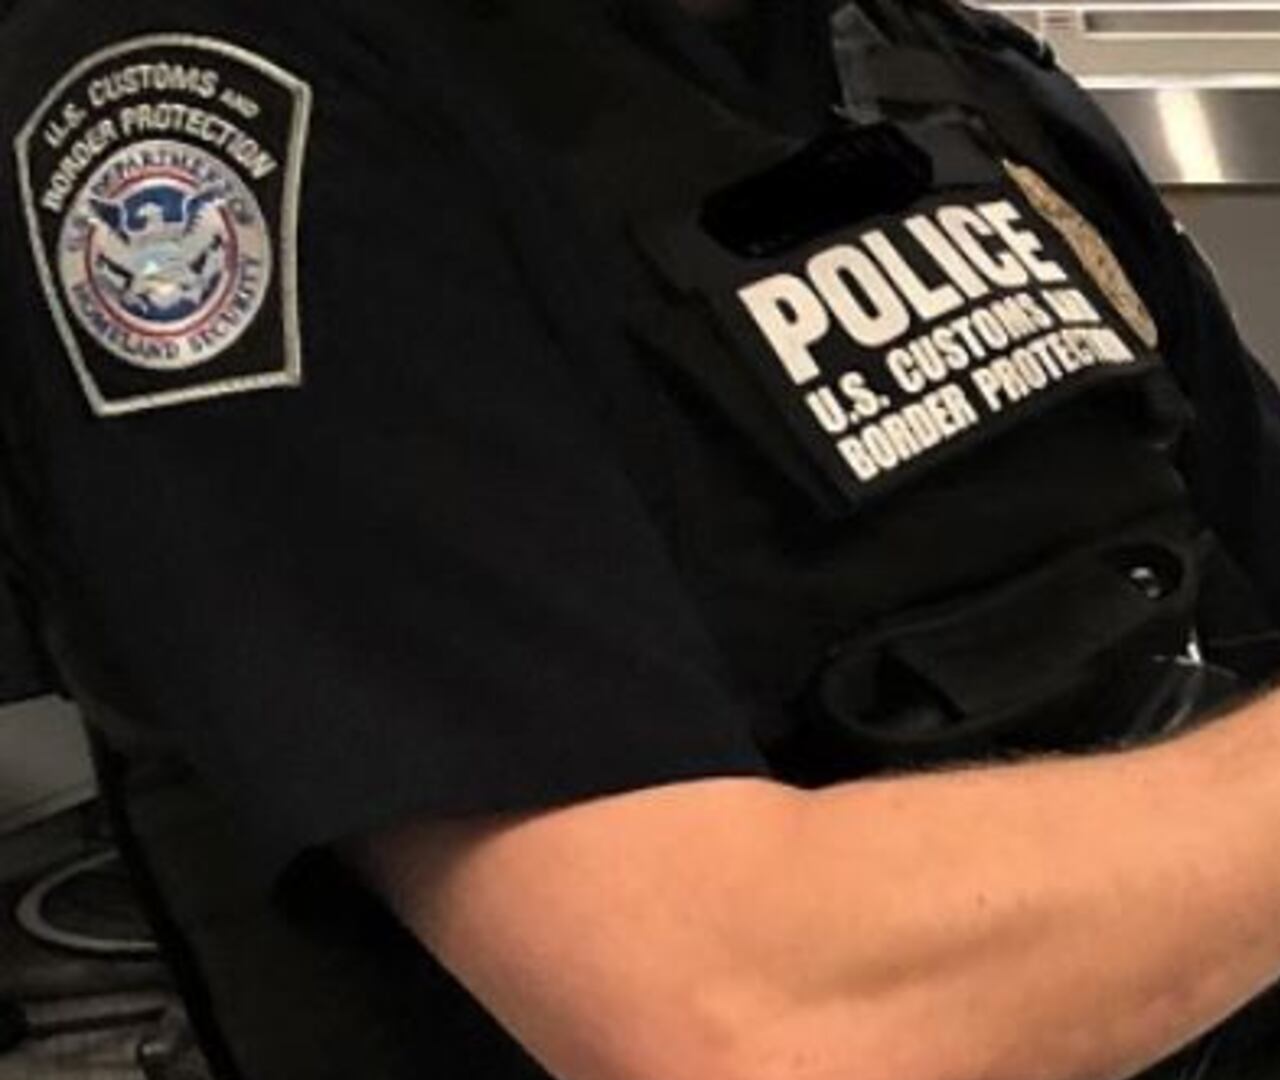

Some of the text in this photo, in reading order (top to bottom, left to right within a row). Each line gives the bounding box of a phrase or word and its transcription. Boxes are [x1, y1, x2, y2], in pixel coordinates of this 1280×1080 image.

[87, 62, 220, 107] CUSTOMS
[41, 102, 278, 214] BORDER PROTECTION
[737, 200, 1068, 386] POLICE
[804, 370, 891, 434] U.S.
[886, 291, 1053, 394] CUSTOMS
[836, 383, 979, 483] BORDER
